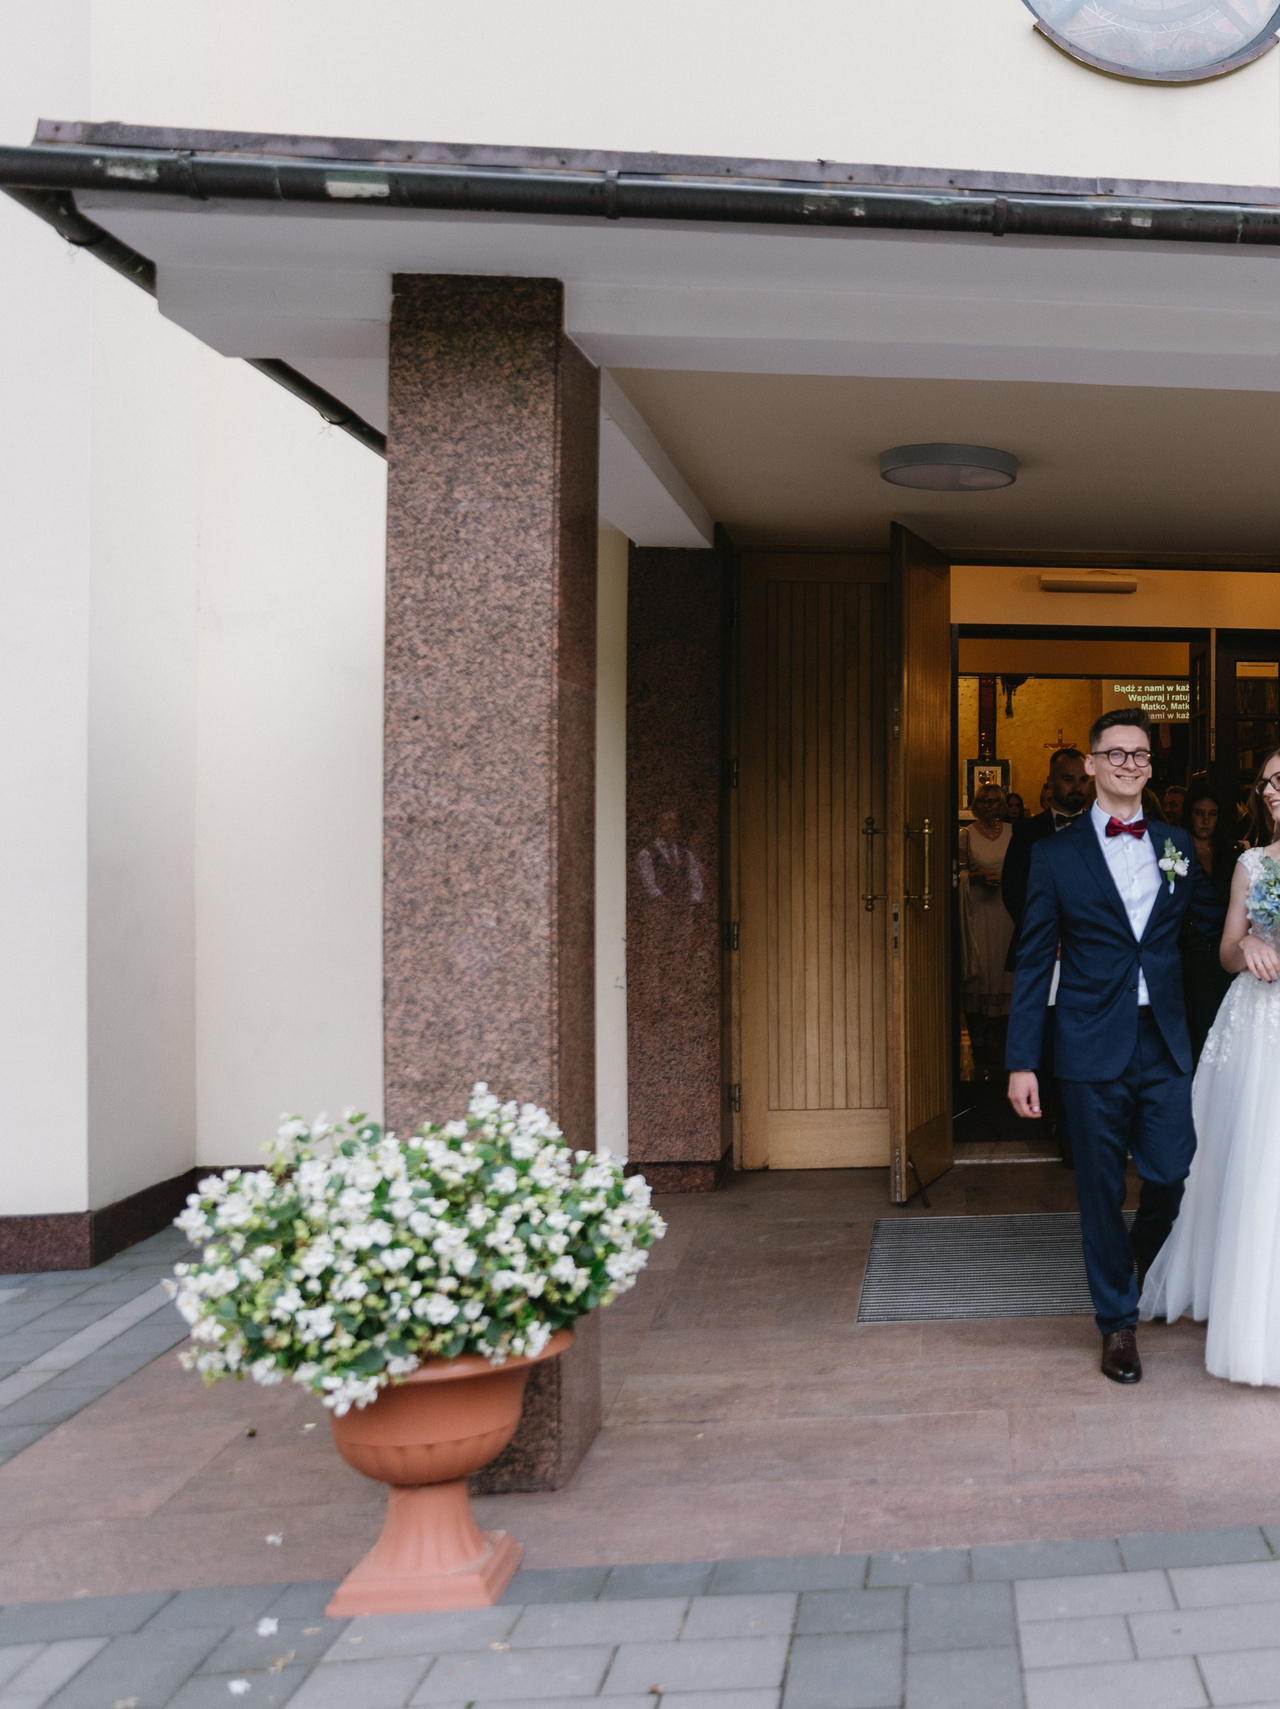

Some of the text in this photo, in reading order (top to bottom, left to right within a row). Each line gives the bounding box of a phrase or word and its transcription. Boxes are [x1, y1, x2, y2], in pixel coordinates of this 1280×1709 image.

[1114, 685, 1135, 693] Bądź
[1128, 694, 1164, 702] Wspieraj
[1172, 694, 1190, 702] ratuj
